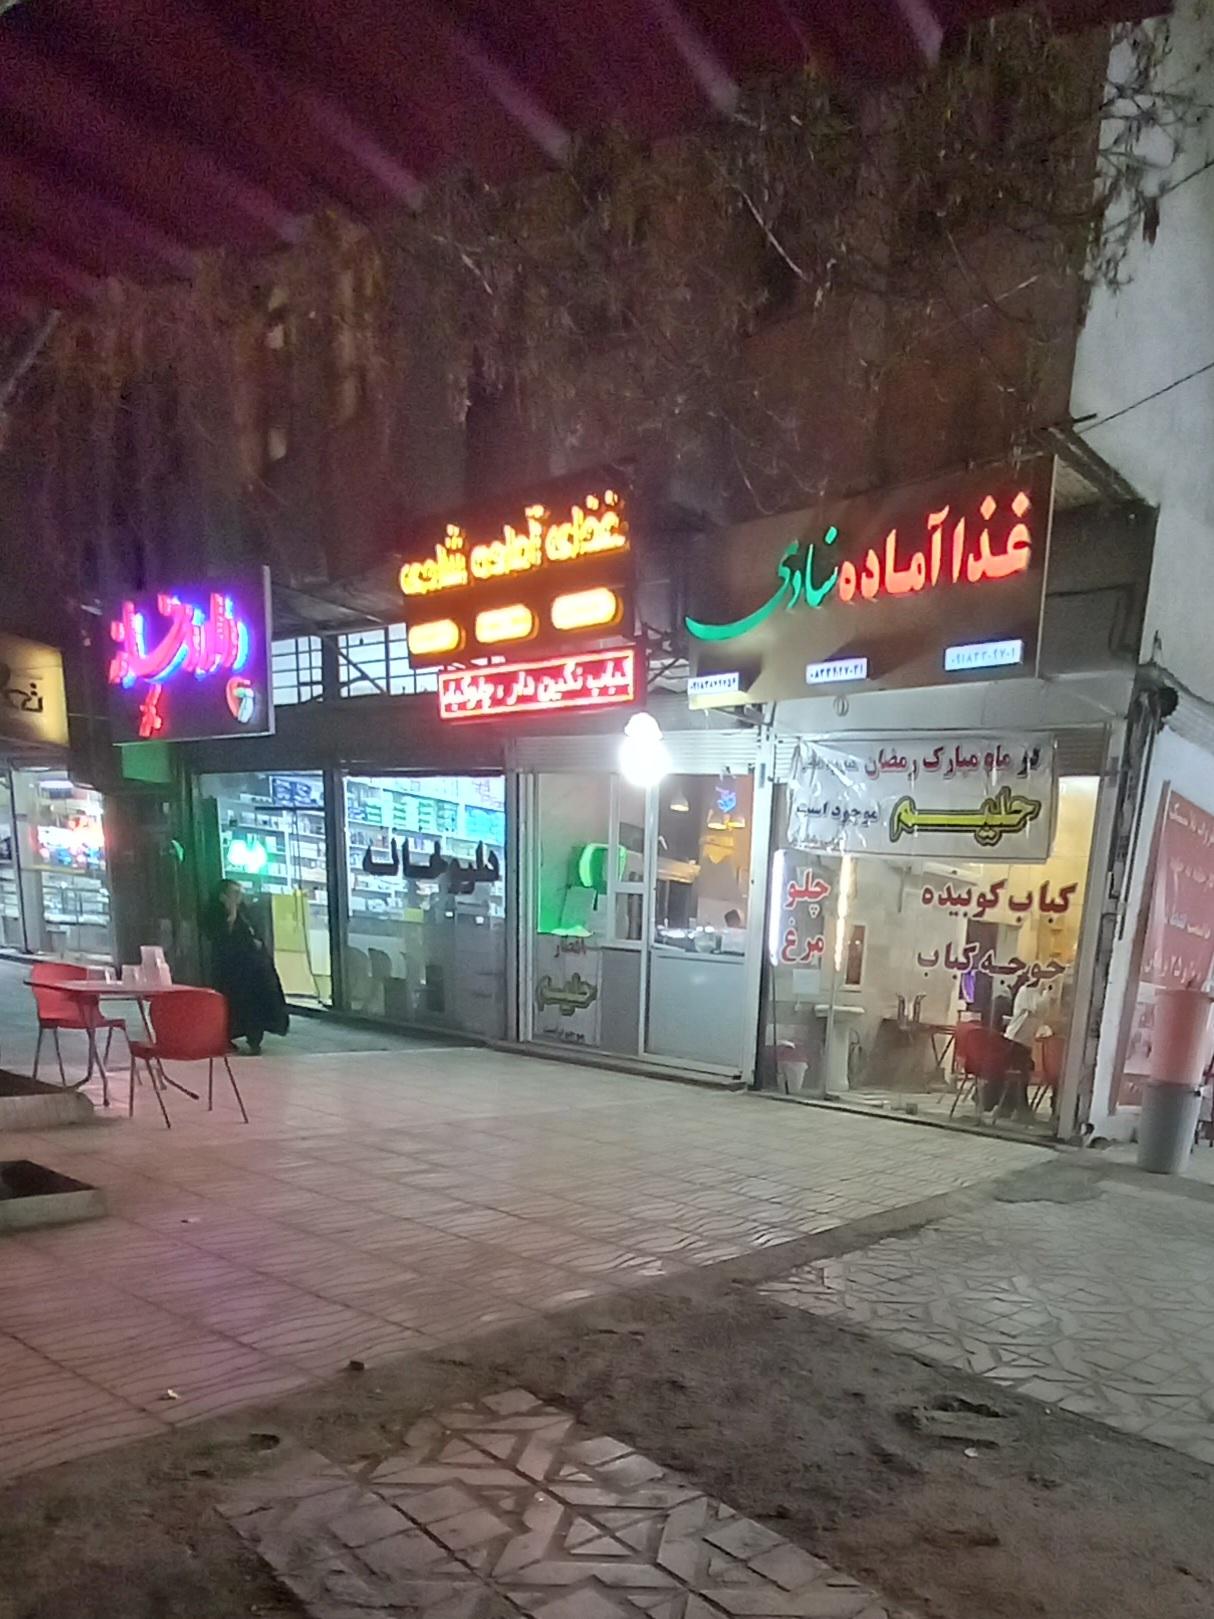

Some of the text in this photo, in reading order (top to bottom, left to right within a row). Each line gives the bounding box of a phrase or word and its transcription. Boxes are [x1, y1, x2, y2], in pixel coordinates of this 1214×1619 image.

[838, 505, 951, 602] آماده
[952, 491, 1033, 583] غذا
[864, 746, 919, 781] رمضان
[922, 745, 979, 781] مبارک
[984, 745, 1011, 774] ماه
[784, 868, 832, 919] چلو
[920, 878, 1078, 924] کباب کوبیده
[780, 917, 826, 963] مرغ
[916, 941, 1067, 992] جوجه کباب
